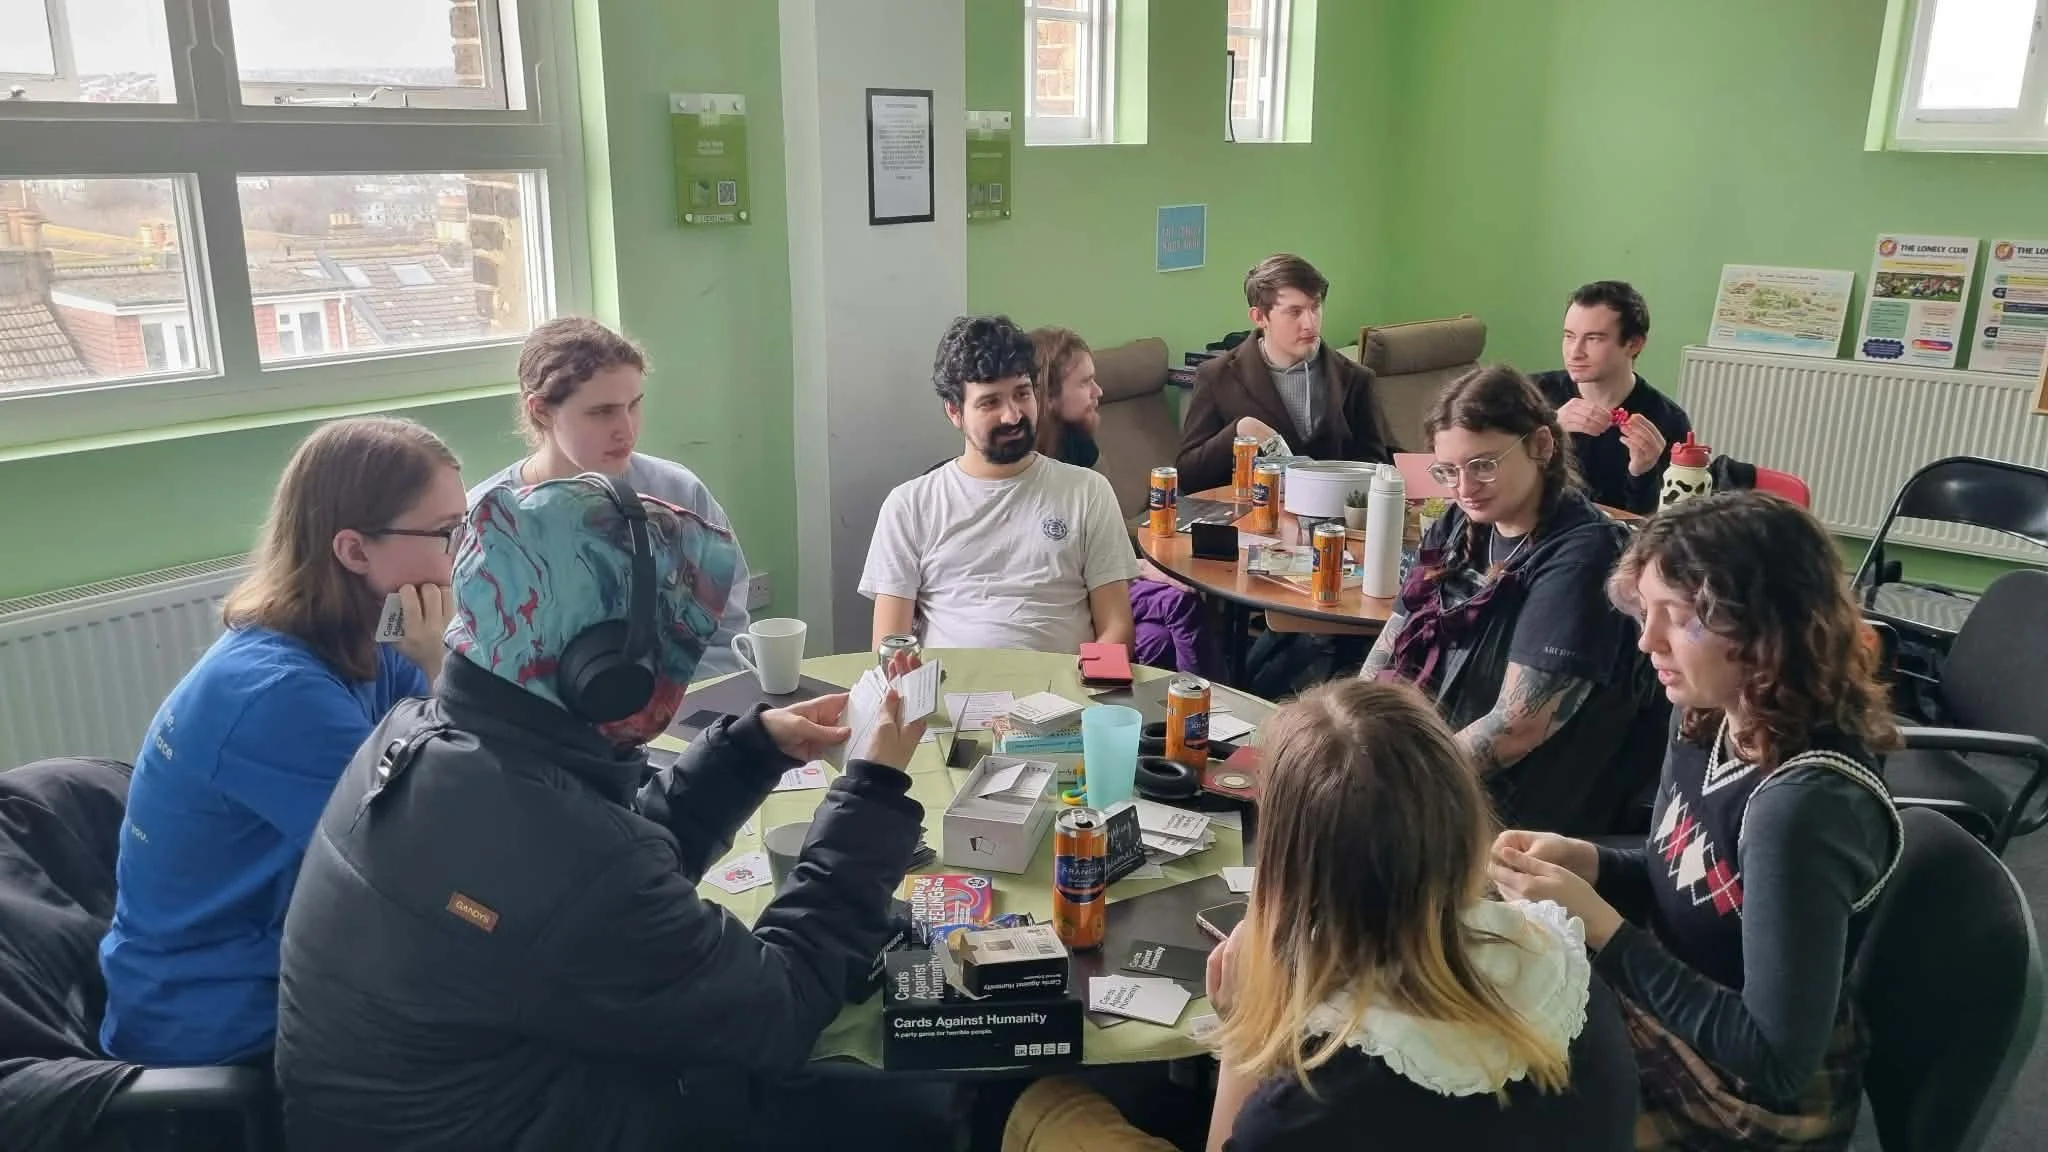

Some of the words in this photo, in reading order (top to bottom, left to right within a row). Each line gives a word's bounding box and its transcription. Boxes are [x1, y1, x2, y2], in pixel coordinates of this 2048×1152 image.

[1900, 244, 1915, 252] THE
[1917, 244, 1946, 253] LONELY
[1948, 246, 1969, 254] CLUB
[2016, 246, 2033, 255] THE
[894, 971, 910, 1001] Cards
[911, 963, 930, 1000] Against
[927, 954, 945, 999] Humanity
[893, 1017, 933, 1029] Cards
[935, 1014, 984, 1029] Against
[986, 1012, 1048, 1026] Humanity
